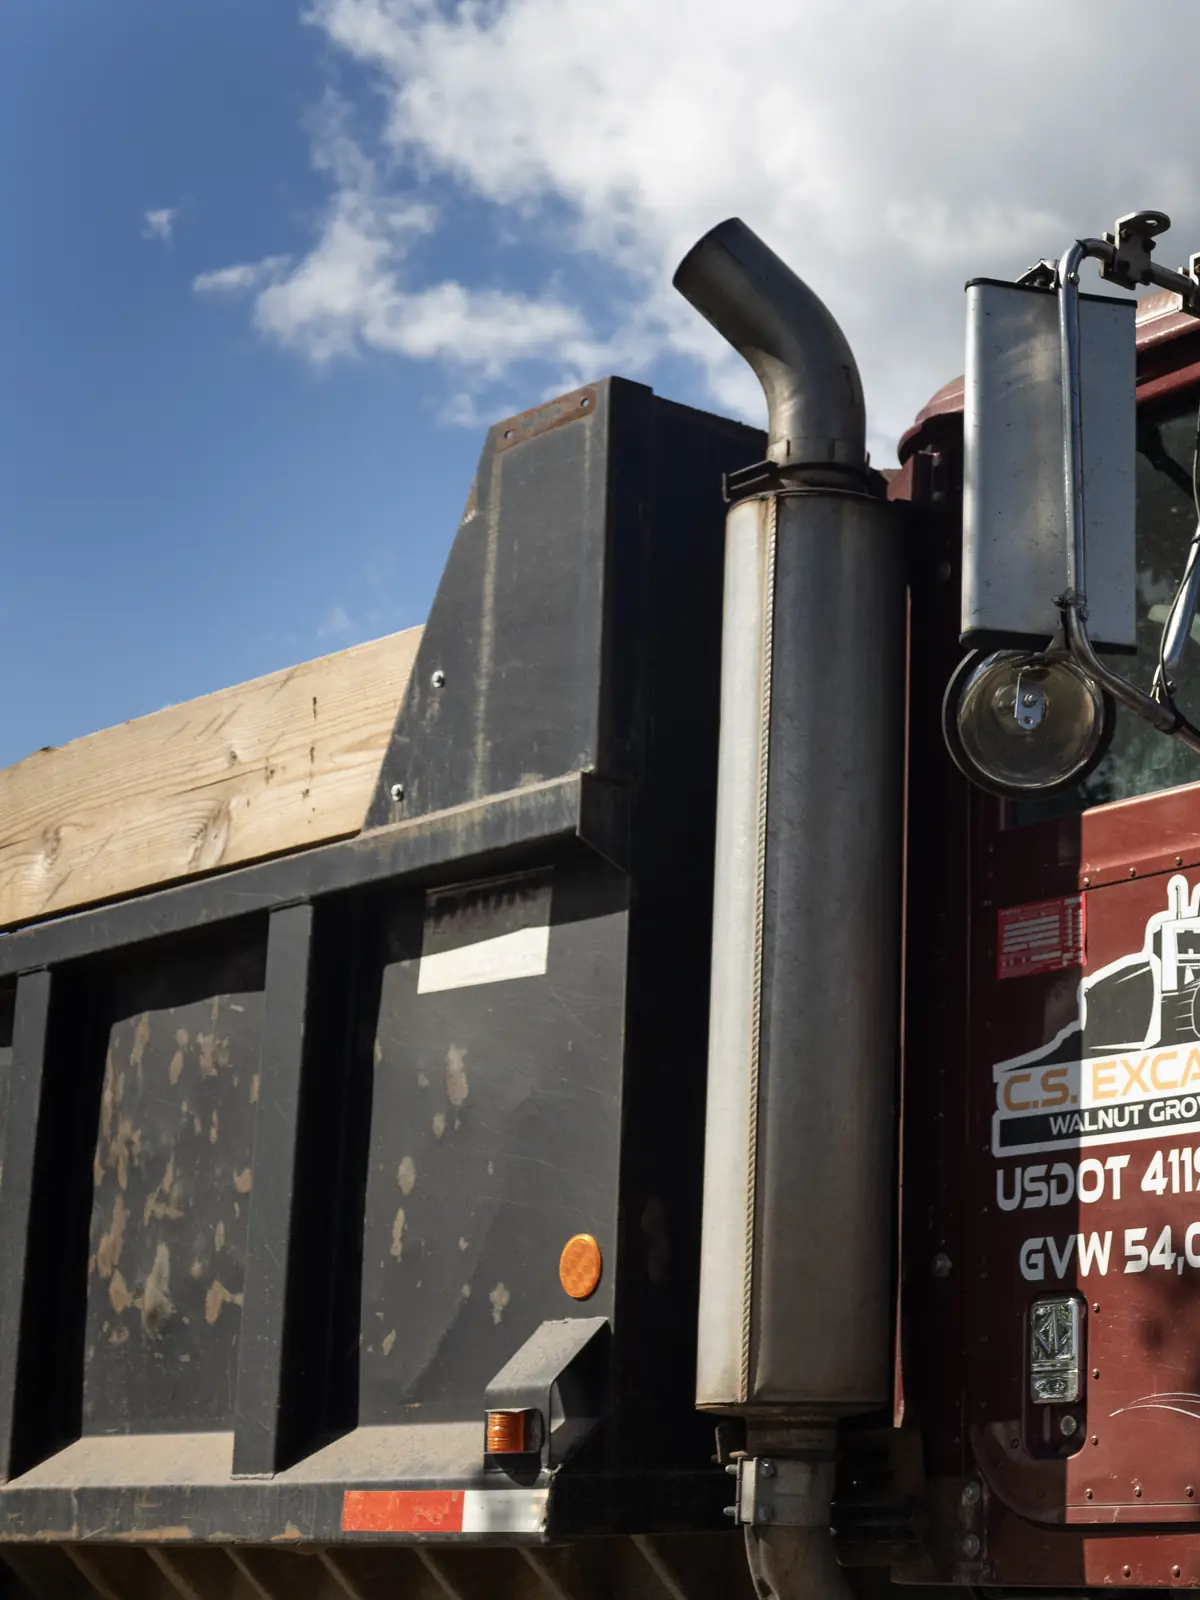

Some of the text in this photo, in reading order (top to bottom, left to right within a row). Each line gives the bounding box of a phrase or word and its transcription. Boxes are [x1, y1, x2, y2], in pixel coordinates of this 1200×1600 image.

[1003, 1068, 1079, 1112] C.S.
[1050, 1104, 1144, 1135] WALNUT
[996, 1154, 1131, 1212] USDOT
[1019, 1230, 1113, 1281] GVW
